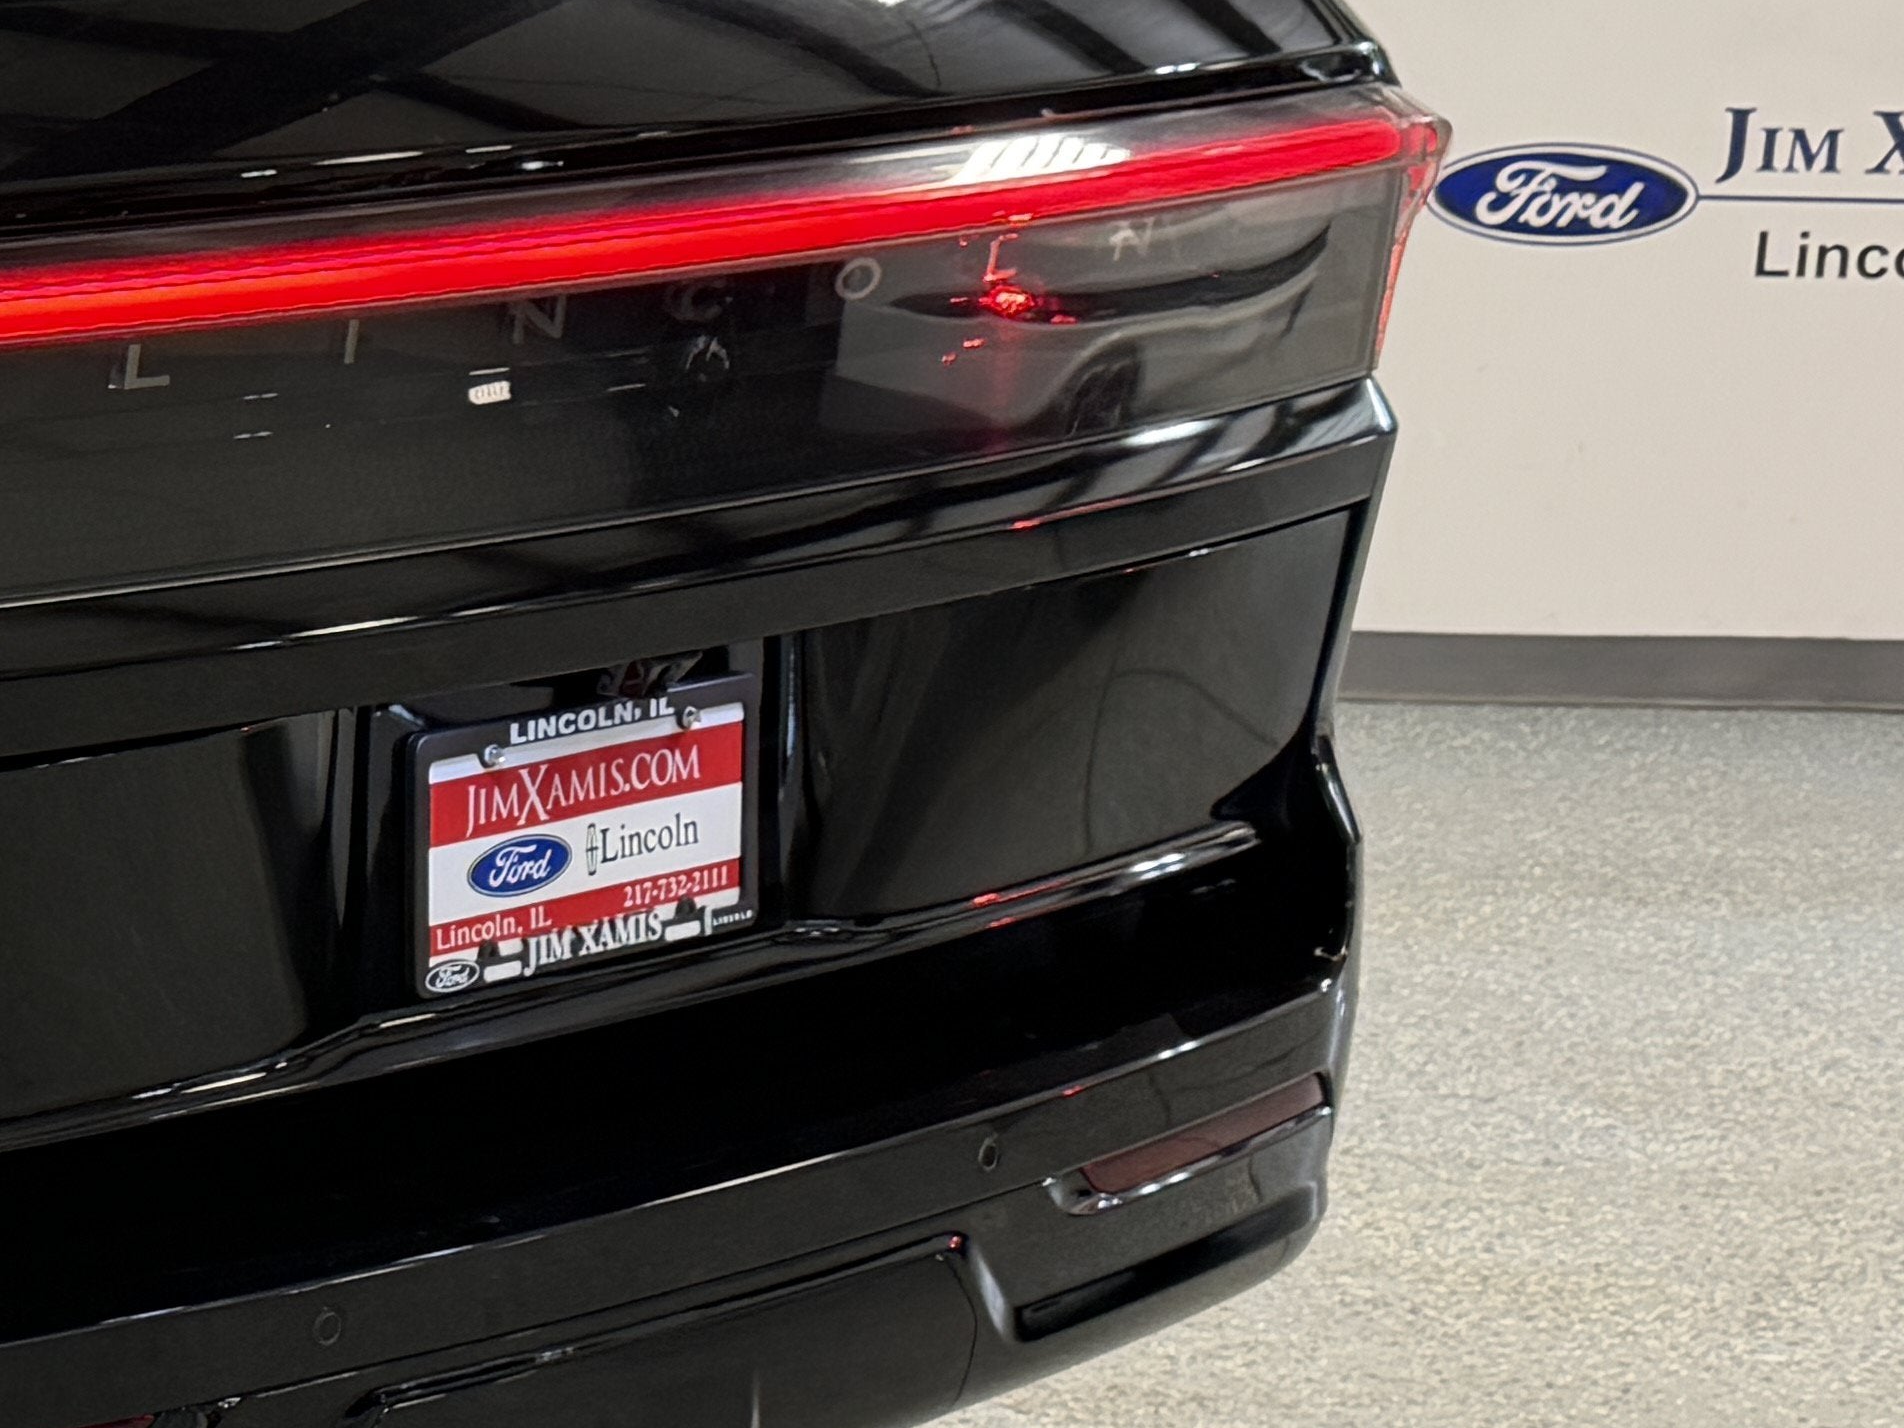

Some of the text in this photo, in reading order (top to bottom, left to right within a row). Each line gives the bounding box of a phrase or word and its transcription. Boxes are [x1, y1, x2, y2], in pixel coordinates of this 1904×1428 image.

[1715, 107, 1844, 184] JIM
[1474, 159, 1646, 230] Ford
[1754, 230, 1904, 280] Linc
[509, 696, 675, 745] LINCOLN, IL
[465, 744, 701, 838] JIMXAMIS.COM
[600, 812, 699, 864] Lincoln
[488, 844, 552, 888] Ford
[622, 864, 729, 908] 217-732-2111
[435, 905, 553, 951] Lincoln, IL
[523, 911, 664, 978] JIM XAMIS
[435, 961, 471, 990] Ford
